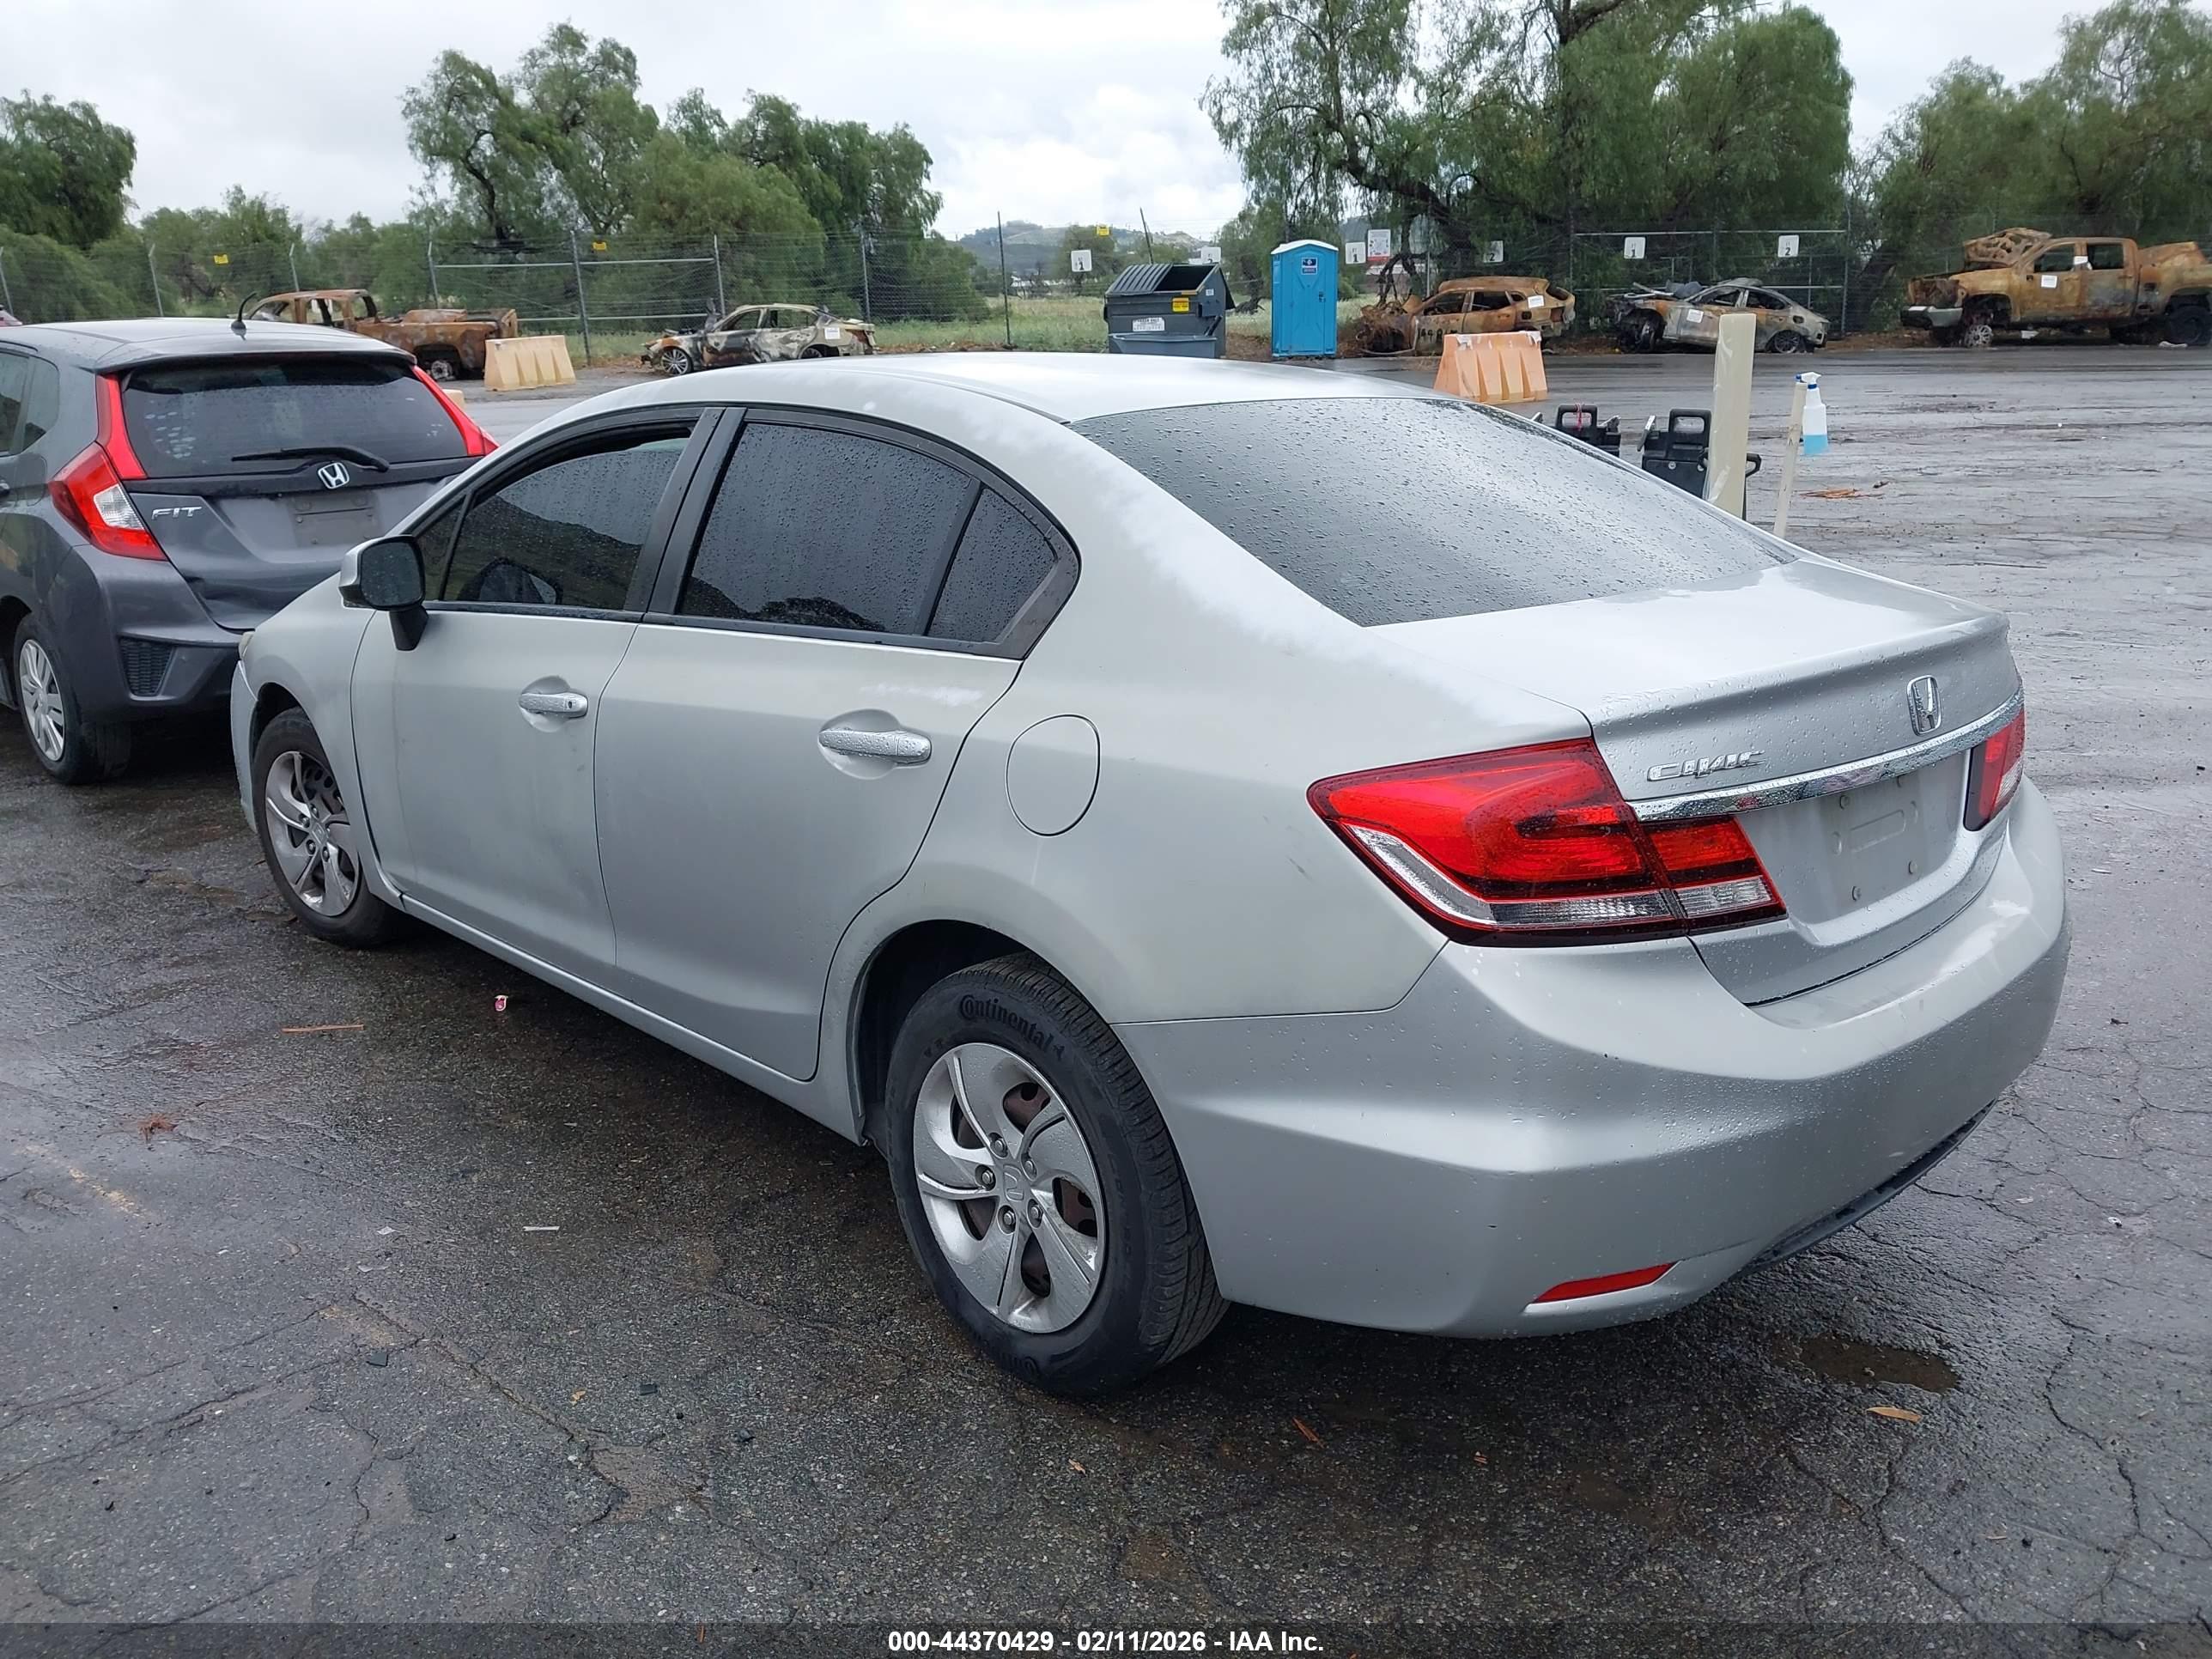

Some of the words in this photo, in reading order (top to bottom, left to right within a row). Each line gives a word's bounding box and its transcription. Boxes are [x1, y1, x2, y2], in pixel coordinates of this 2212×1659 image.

[151, 506, 203, 520] FIT
[1647, 750, 1765, 782] CIVIC
[960, 994, 1054, 1054] Continental
